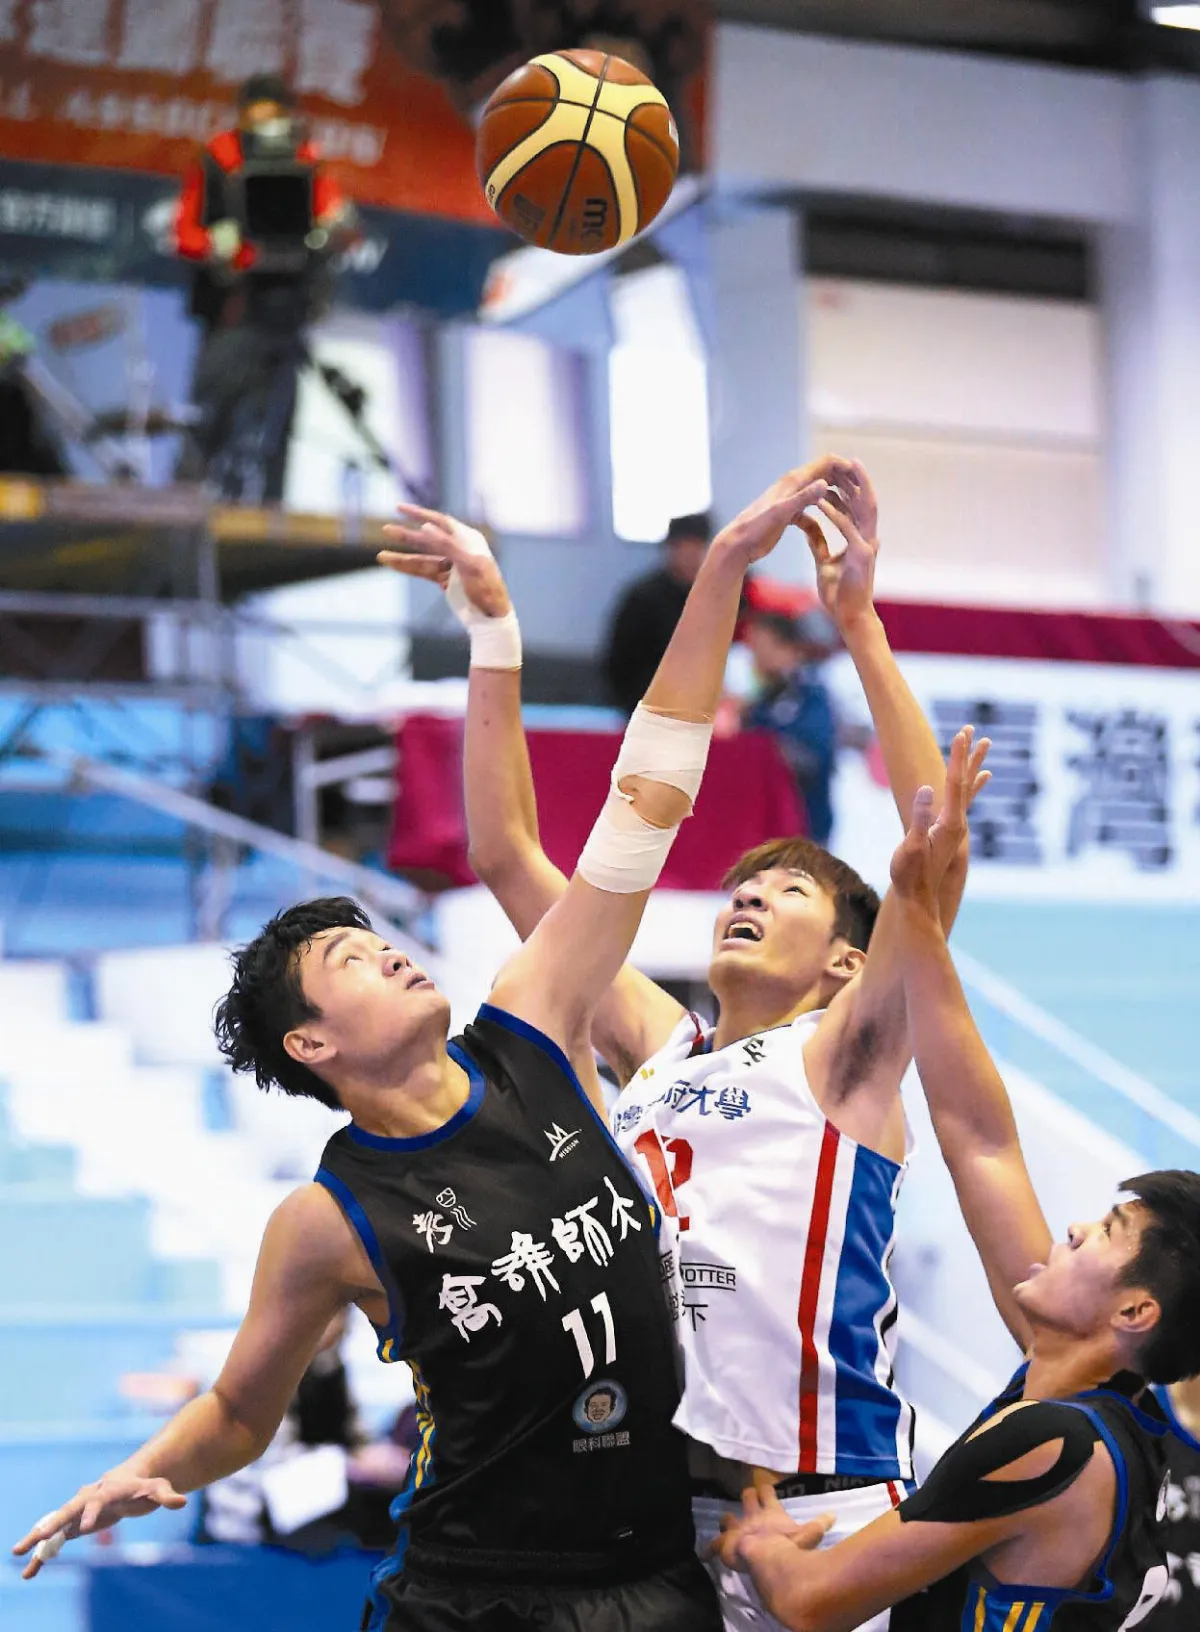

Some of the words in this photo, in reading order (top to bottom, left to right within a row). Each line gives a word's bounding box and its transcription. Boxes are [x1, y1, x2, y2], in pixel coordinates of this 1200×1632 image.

[932, 698, 1200, 872] 臺灣
[559, 1139, 580, 1159] MISSION
[561, 1291, 617, 1380] 11
